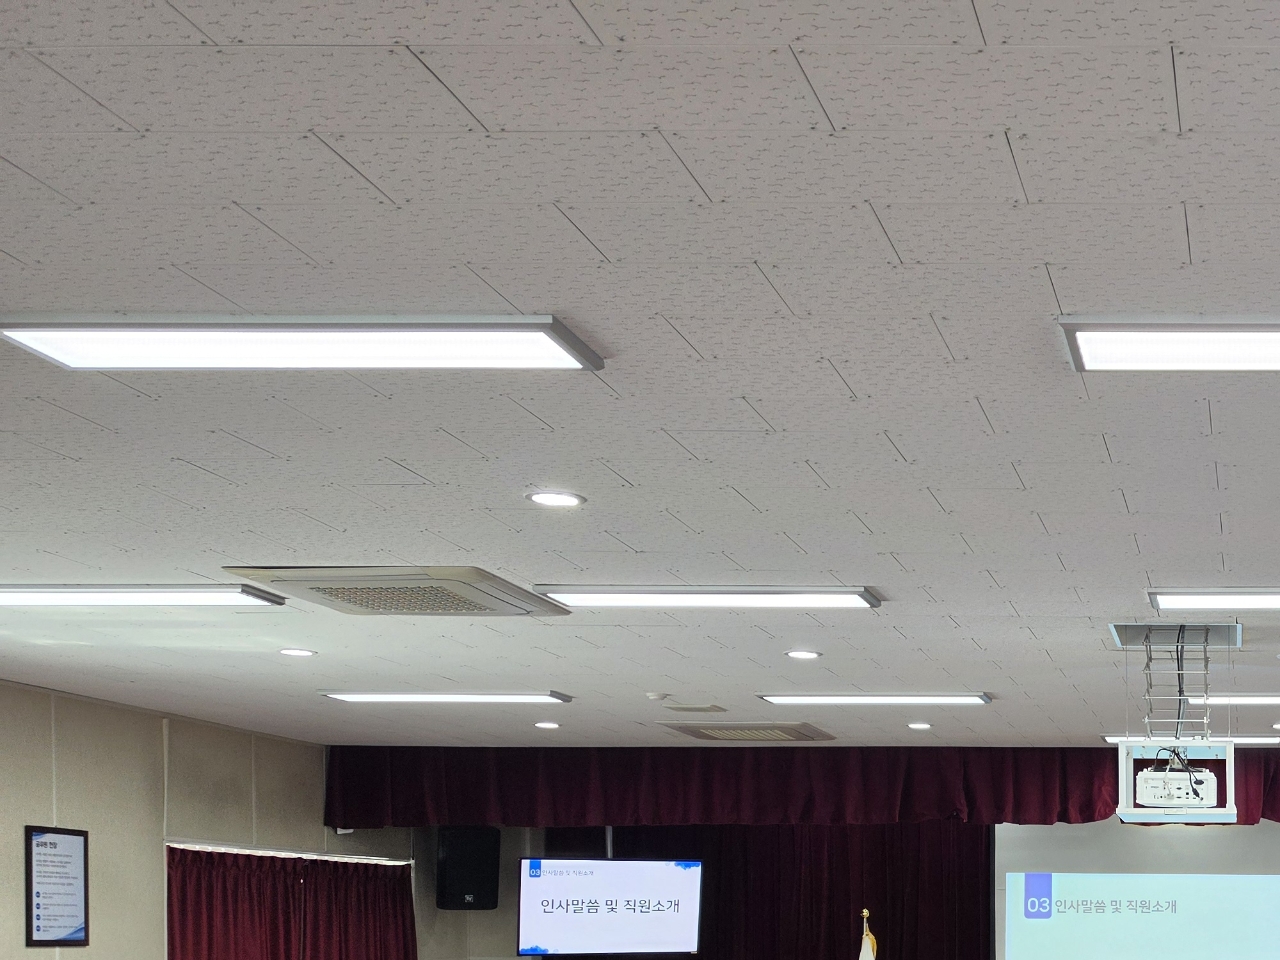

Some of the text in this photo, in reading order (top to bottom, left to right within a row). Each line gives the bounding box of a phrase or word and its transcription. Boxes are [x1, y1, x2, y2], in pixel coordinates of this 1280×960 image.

[541, 898, 680, 914] 인사말씀 및 직원소개
[1027, 897, 1177, 914] 03 인사말씀 및 직원소개
